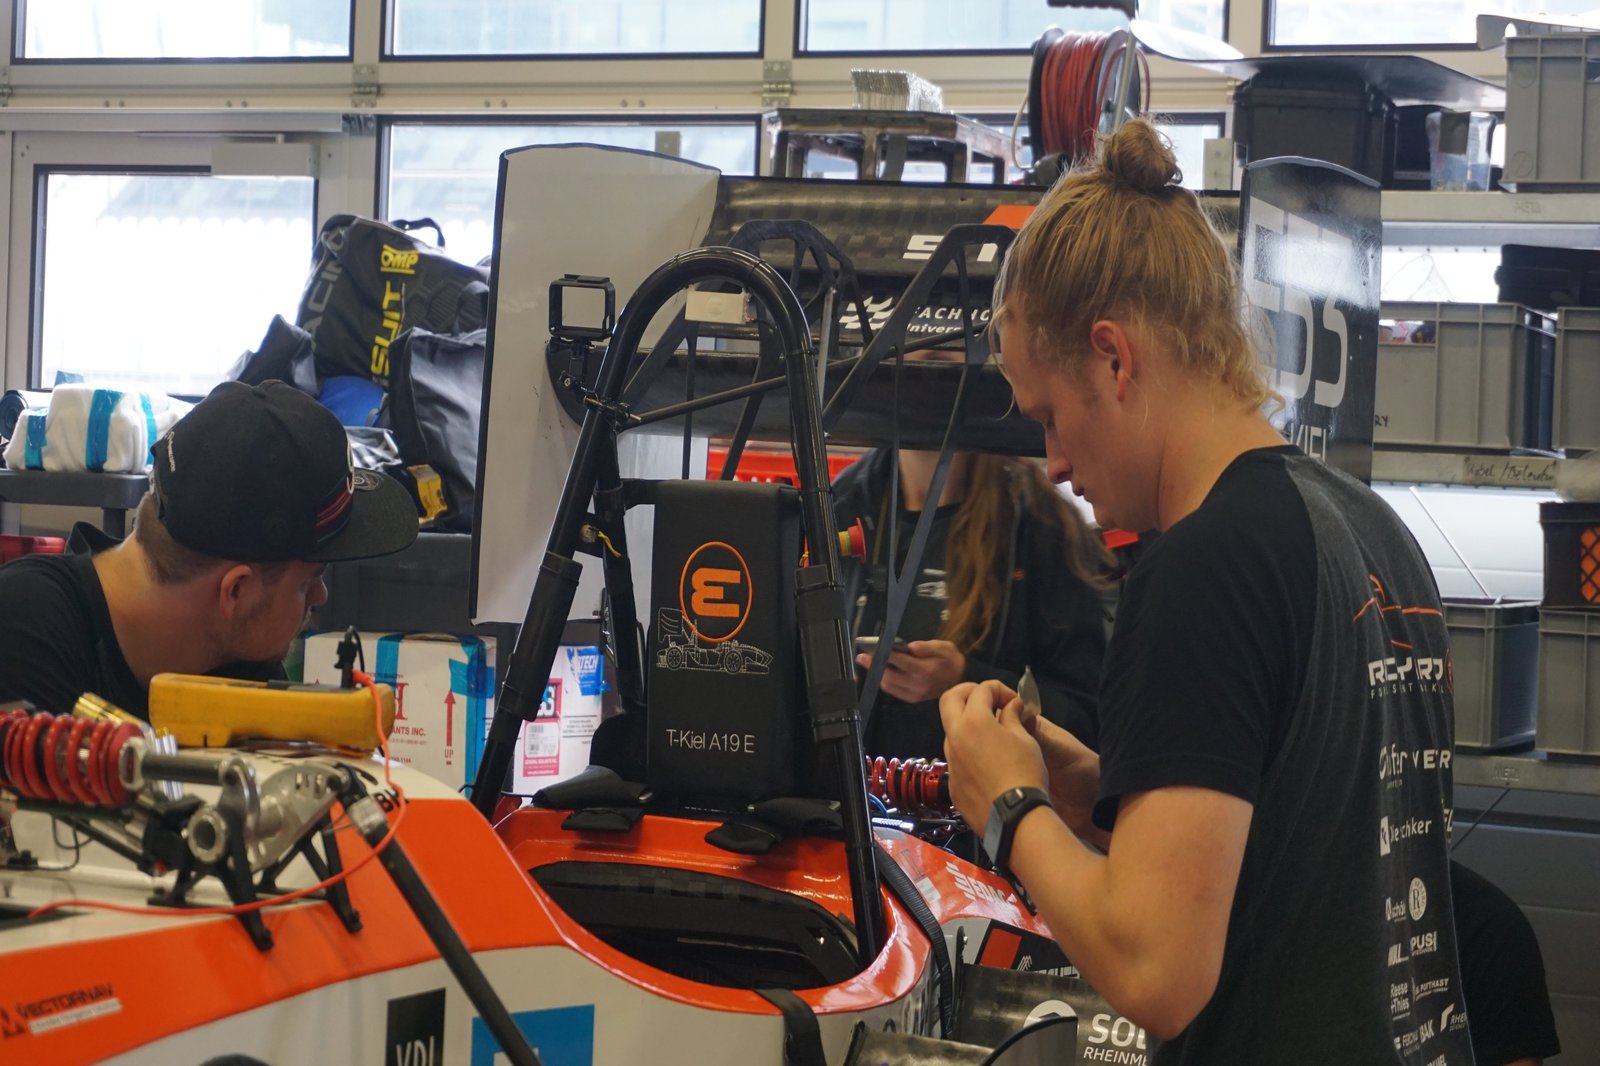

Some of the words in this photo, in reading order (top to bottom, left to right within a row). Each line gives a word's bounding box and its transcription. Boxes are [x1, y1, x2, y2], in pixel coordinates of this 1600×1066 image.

[380, 247, 420, 273] OMP
[665, 728, 706, 750] T-Kiel
[709, 732, 741, 752] A19
[743, 734, 756, 754] E
